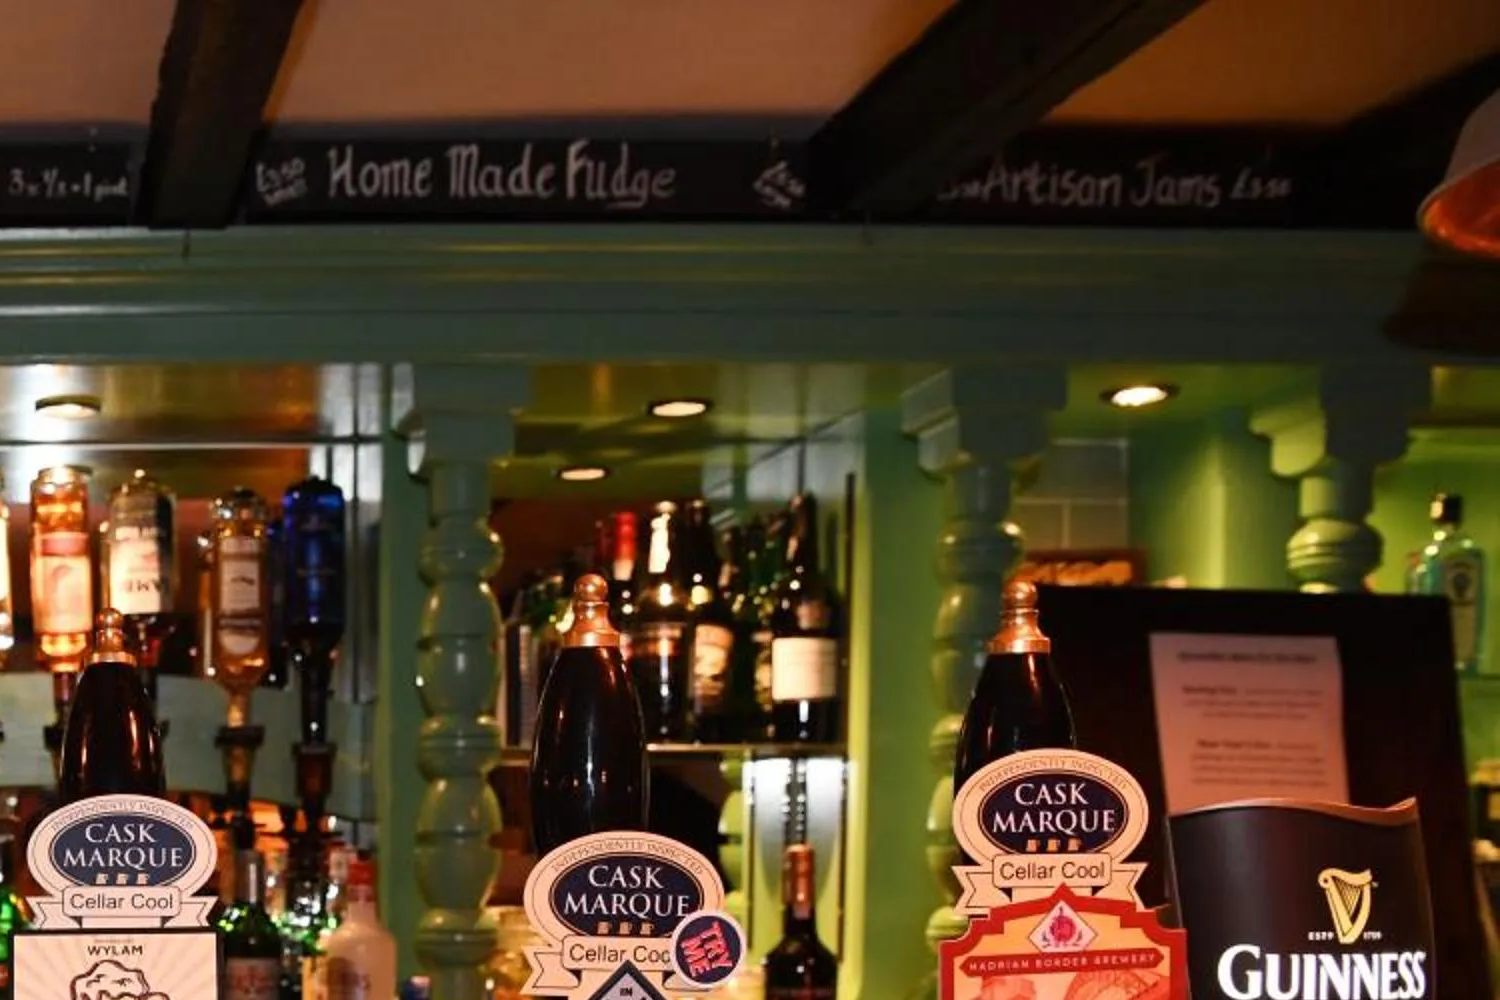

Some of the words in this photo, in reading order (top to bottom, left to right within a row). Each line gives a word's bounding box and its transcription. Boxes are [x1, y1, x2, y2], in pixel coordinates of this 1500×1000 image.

[326, 143, 434, 199] Home
[445, 143, 556, 199] Made
[565, 137, 677, 210] Fudge
[981, 154, 1124, 207] Artisan
[1130, 152, 1222, 208] Jams
[1014, 782, 1089, 806] CASK
[85, 823, 157, 843] CASK
[992, 808, 1116, 836] MARQUE
[63, 847, 183, 870] MARQUE
[999, 860, 1057, 880] Cellar
[1061, 861, 1106, 880] Cool
[588, 864, 664, 889] CASK
[69, 893, 125, 909] Cellar
[131, 893, 173, 909] Cool
[563, 891, 690, 919] MARQUE
[87, 945, 143, 956] WYLAM
[569, 943, 627, 963] Cellar
[633, 945, 671, 963] Coo
[701, 920, 733, 968] TRY
[680, 939, 711, 978] ME
[969, 959, 1030, 971] HADRIAN
[1036, 956, 1088, 969] BORDER
[1094, 953, 1156, 967] BREWERY
[1217, 943, 1427, 1000] GUINNESS
